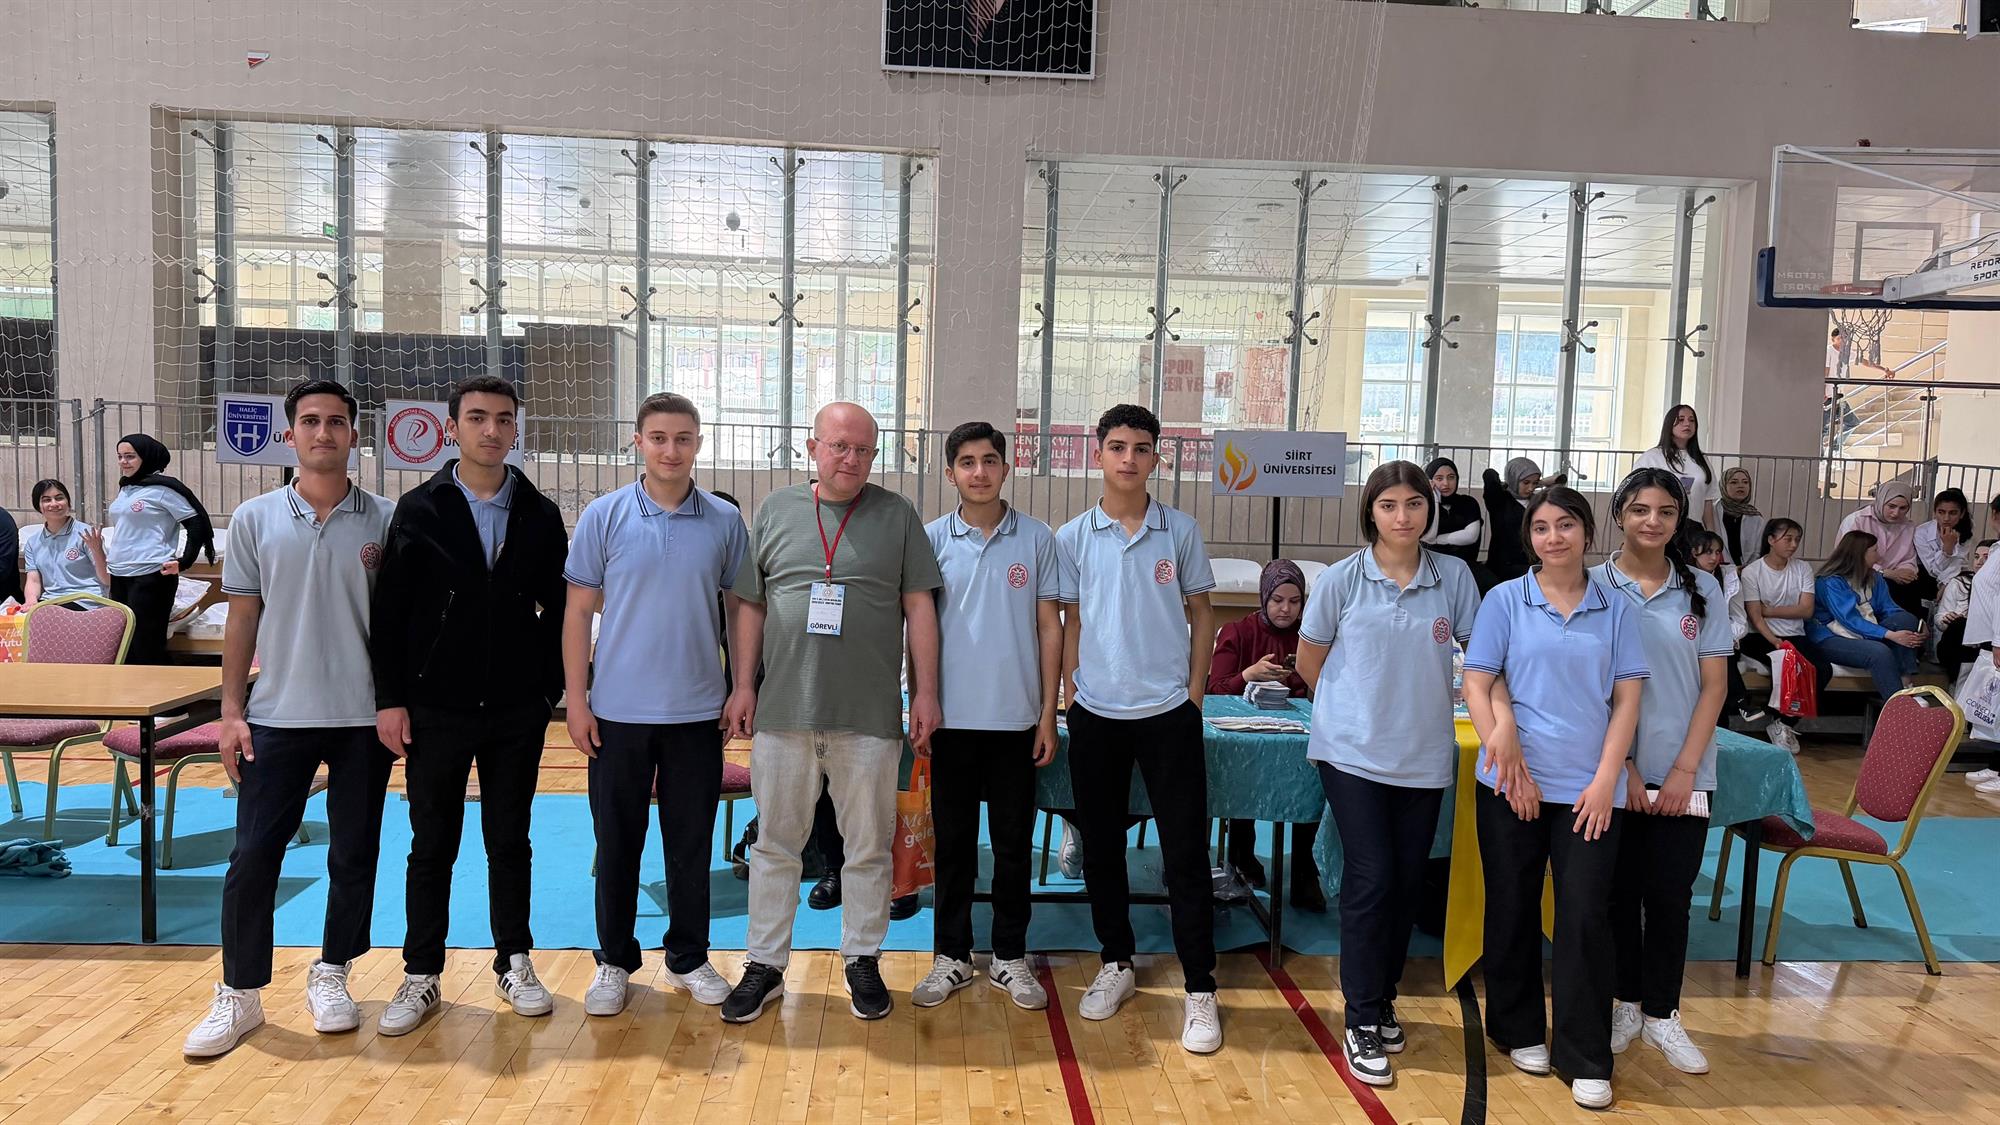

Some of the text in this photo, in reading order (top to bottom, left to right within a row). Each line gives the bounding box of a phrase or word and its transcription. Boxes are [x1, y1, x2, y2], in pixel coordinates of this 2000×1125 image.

[1970, 257, 2000, 270] REFOR
[1285, 449, 1312, 461] SİİRT
[1263, 463, 1336, 475] ÜNİVERSİTESİ
[810, 622, 838, 631] GÖREVLİ
